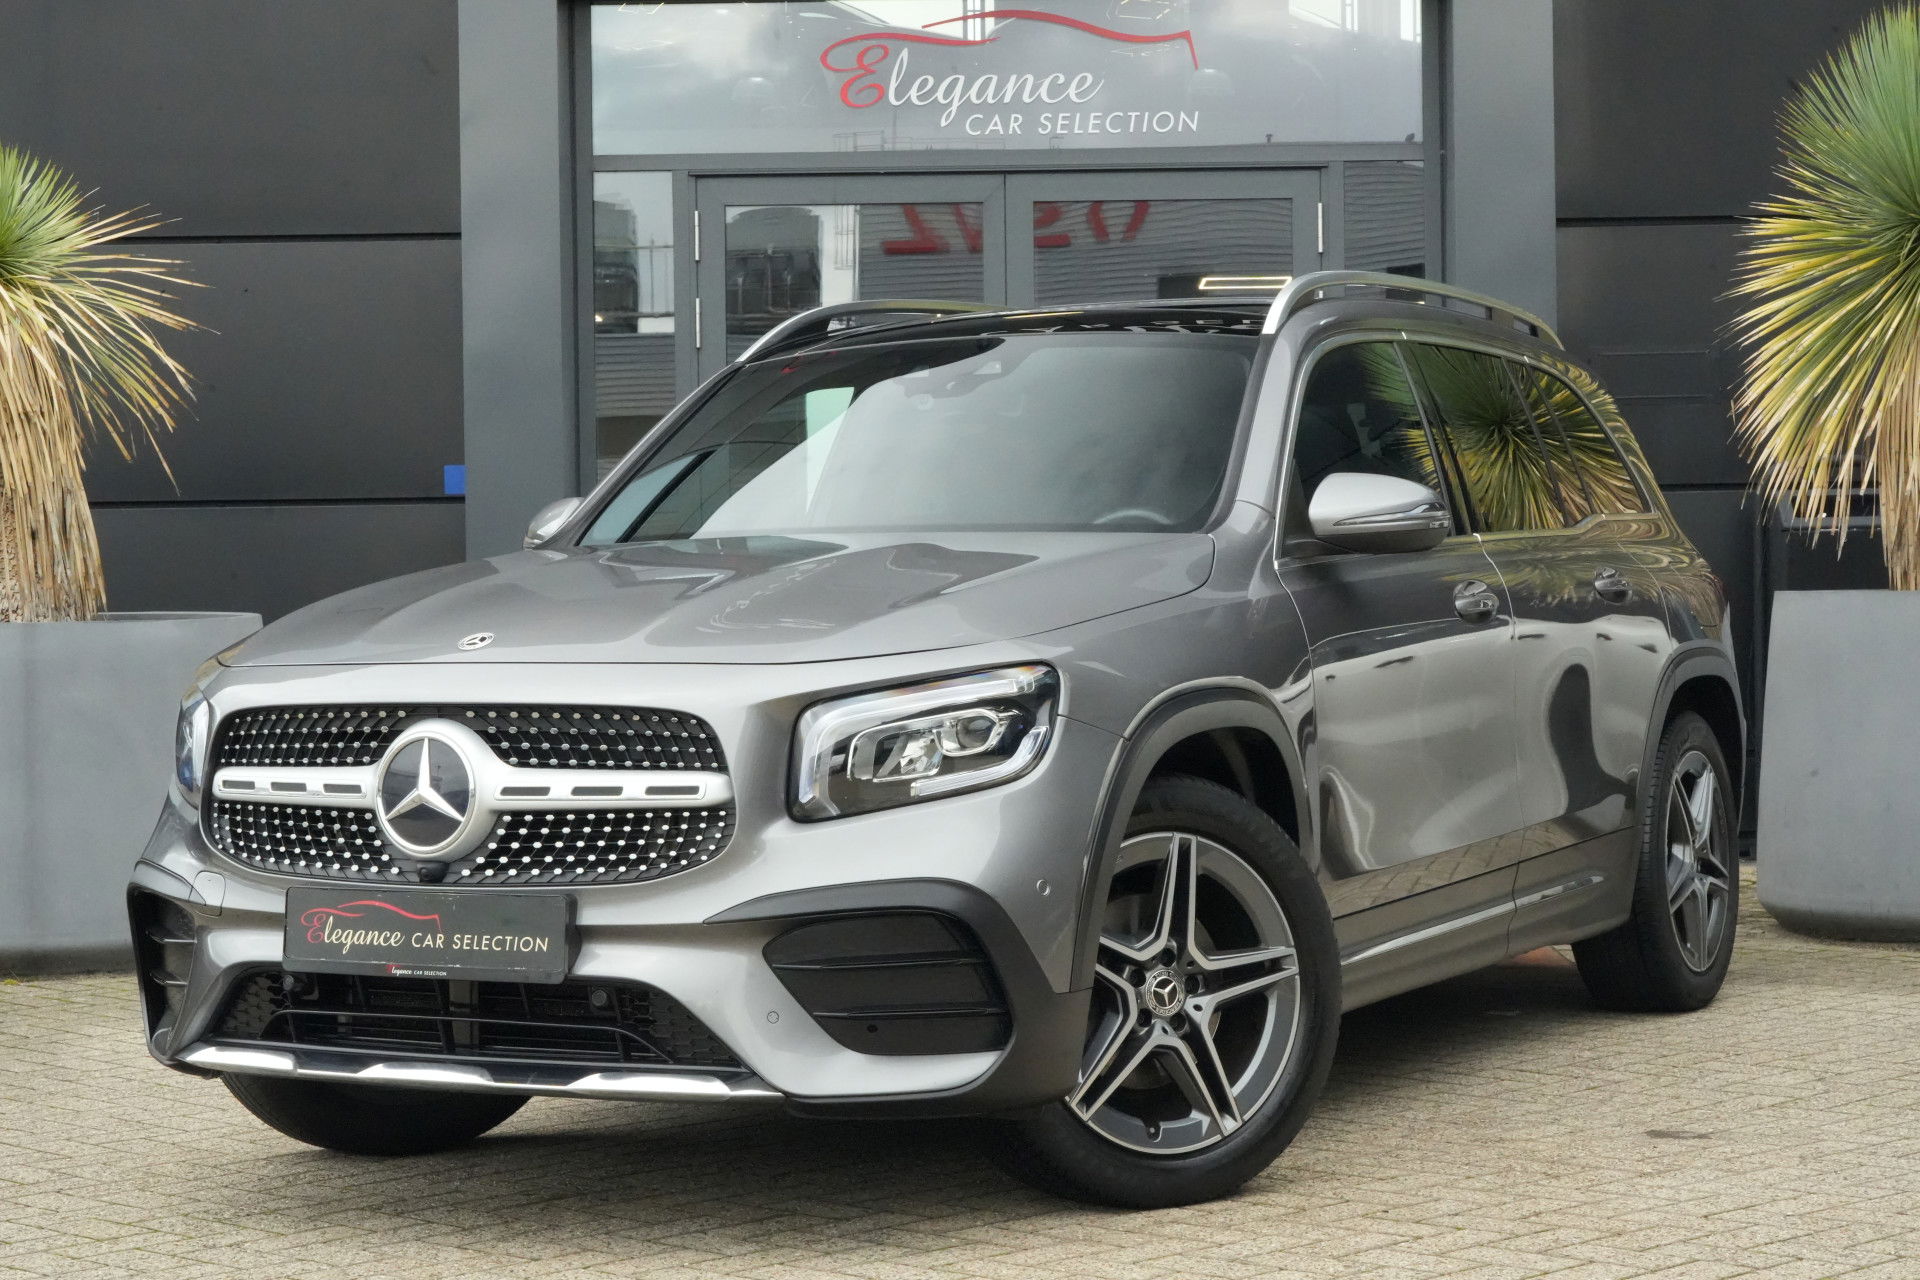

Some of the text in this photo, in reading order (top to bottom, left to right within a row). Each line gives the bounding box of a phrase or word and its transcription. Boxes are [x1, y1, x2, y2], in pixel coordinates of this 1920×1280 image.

[820, 33, 1104, 128] Elegance
[965, 110, 1200, 136] CAR SELECTION
[301, 908, 549, 955] Elegance CAR SELECTION
